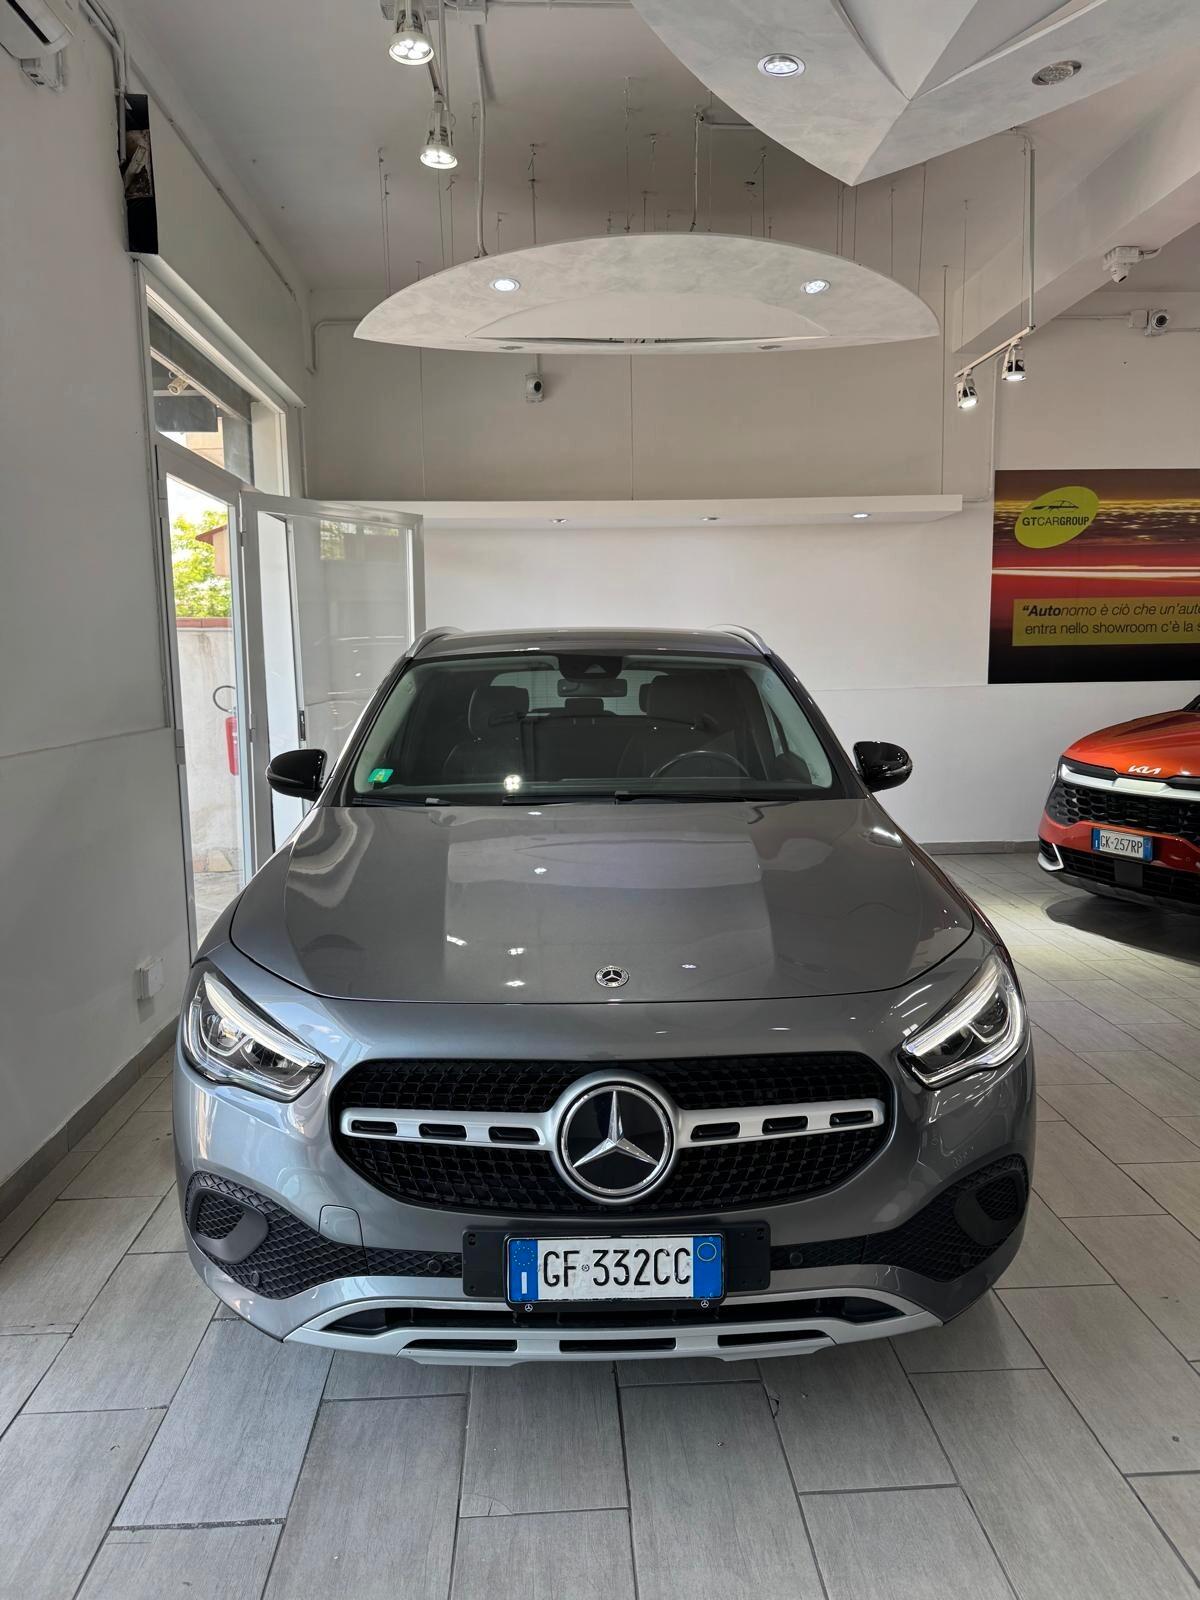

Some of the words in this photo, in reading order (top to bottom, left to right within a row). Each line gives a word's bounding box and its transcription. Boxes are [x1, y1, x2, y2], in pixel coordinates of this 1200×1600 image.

[1100, 604, 1109, 616] è
[1111, 603, 1130, 616] ciò
[1133, 603, 1156, 616] che
[1025, 624, 1057, 635] entra
[1060, 622, 1089, 634] nello
[1092, 621, 1157, 634] showroom
[1183, 620, 1194, 633] la
